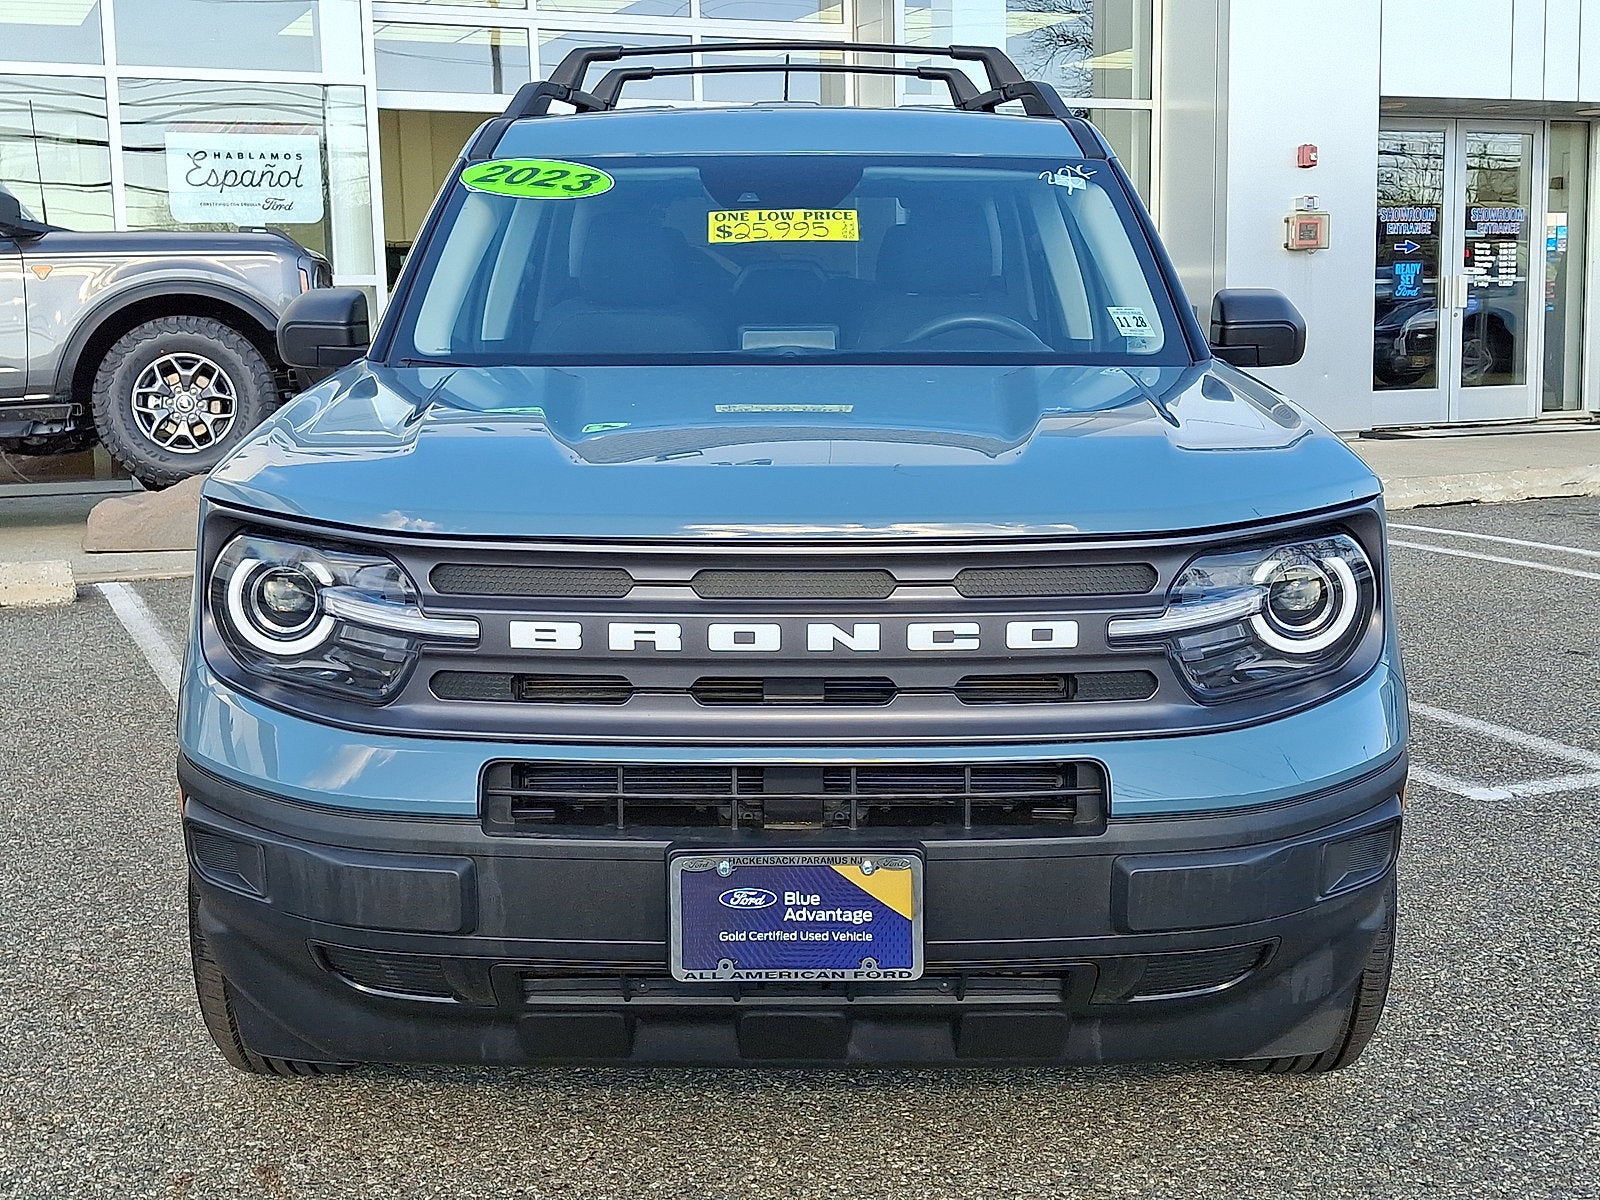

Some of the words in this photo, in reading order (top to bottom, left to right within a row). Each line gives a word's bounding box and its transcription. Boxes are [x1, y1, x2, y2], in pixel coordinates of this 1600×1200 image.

[213, 152, 303, 160] HABLAMOS
[185, 150, 303, 193] Español
[471, 165, 601, 192] 2023
[262, 197, 293, 211] Ford
[714, 211, 750, 222] ONE
[758, 211, 795, 221] LOW
[803, 210, 853, 220] PRICE
[1380, 207, 1437, 221] SHOWROOM
[1471, 207, 1525, 221] SHOWROOM
[1386, 222, 1432, 234] ENTRANCE
[1477, 222, 1520, 233] ENTRANCE
[1395, 263, 1421, 275] READY
[1400, 274, 1416, 285] SET
[1394, 284, 1420, 296] Ford
[508, 619, 1080, 652] BRONCO
[729, 890, 766, 906] Ford
[784, 891, 820, 905] Blue
[784, 907, 873, 924] Advantage
[719, 931, 747, 941] Gold
[748, 931, 797, 941] Certified
[800, 931, 829, 941] Used
[832, 931, 873, 941] Vehicle
[684, 971, 723, 980] ALL
[730, 971, 845, 980] AMERICAN
[854, 971, 913, 979] FORD
